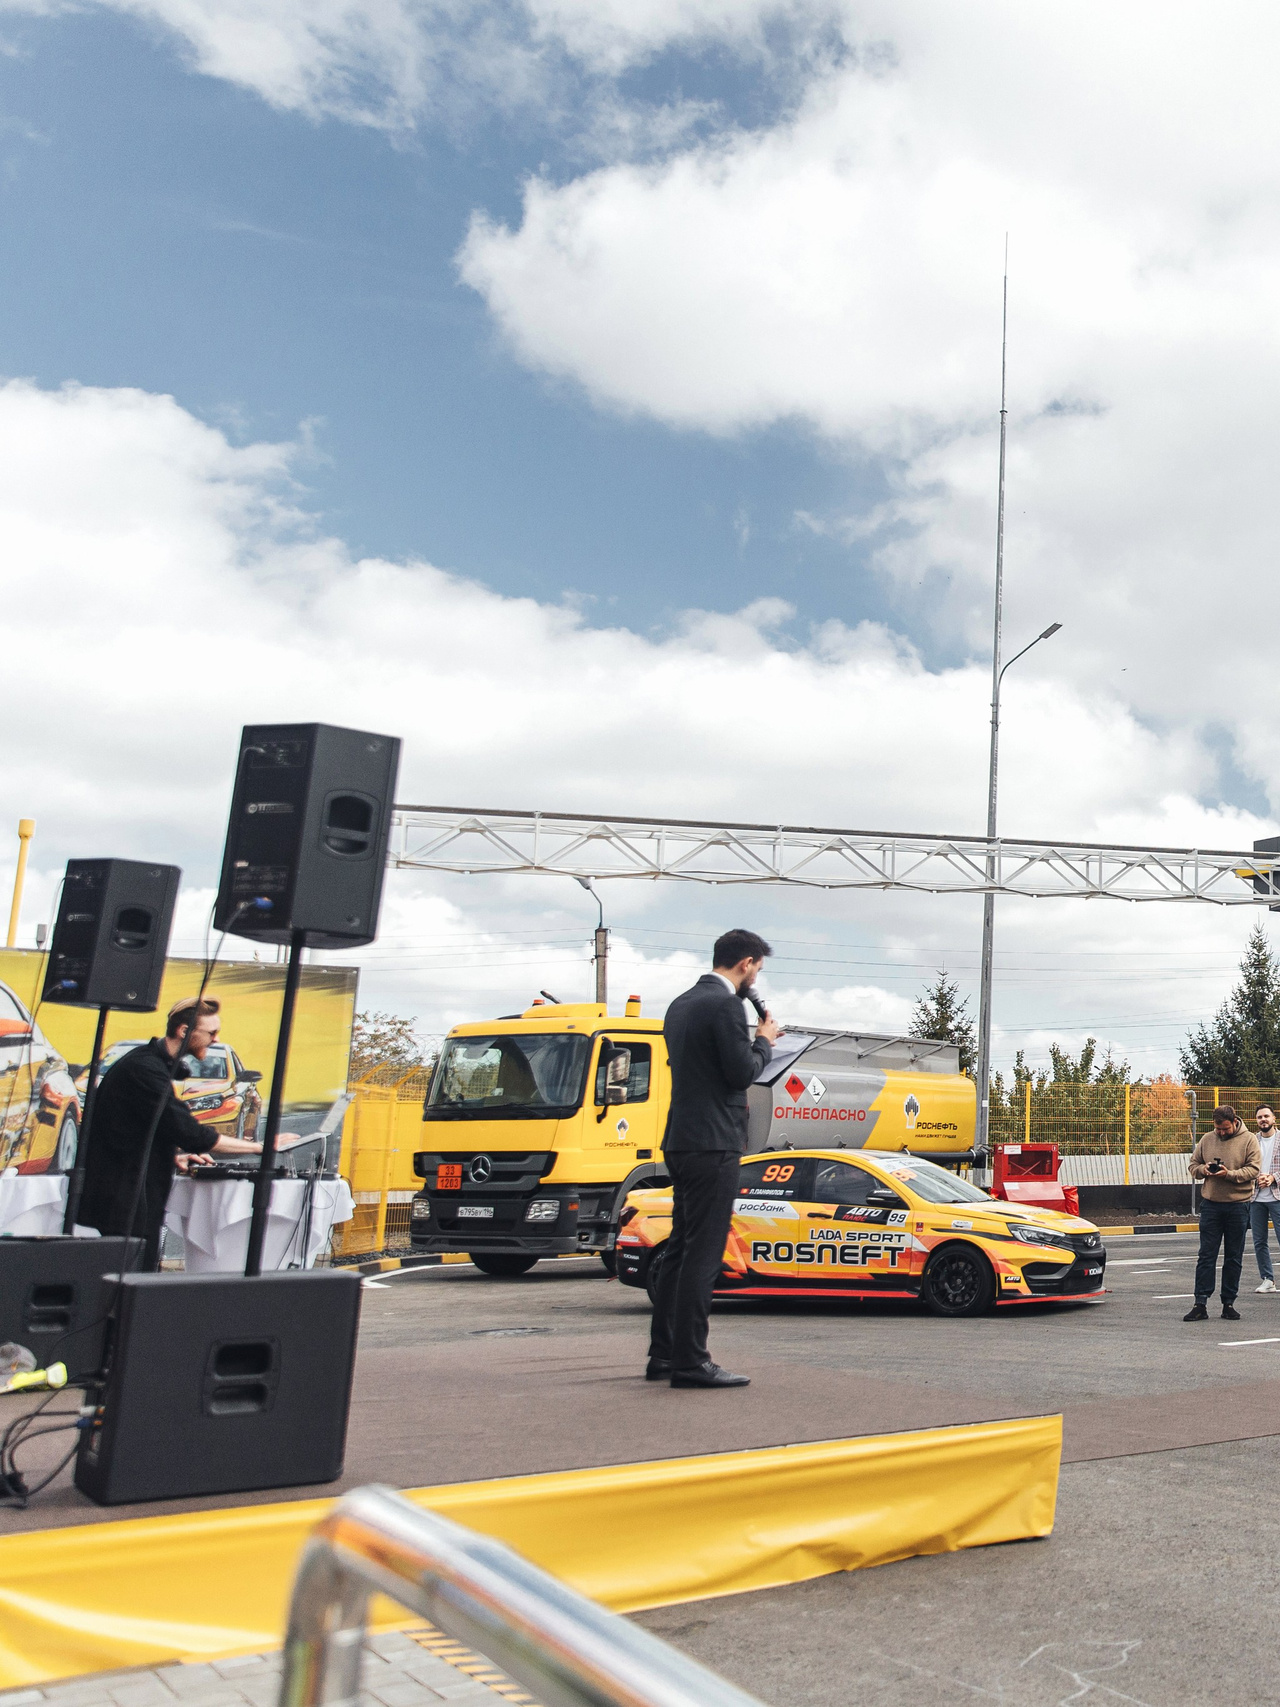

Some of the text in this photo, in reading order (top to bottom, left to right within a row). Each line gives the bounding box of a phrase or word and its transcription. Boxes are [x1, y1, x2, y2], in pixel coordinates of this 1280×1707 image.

[774, 1106, 866, 1122] ОГНЕОПАСНО
[916, 1121, 958, 1130] РОСНЕФТЬ
[445, 1165, 455, 1175] 33
[762, 1164, 795, 1183] 99
[440, 1178, 459, 1188] 1203
[738, 1202, 786, 1212] росбанк
[846, 1207, 883, 1217] АВТО
[842, 1214, 868, 1222] ПЛЮС
[889, 1213, 907, 1223] 99
[810, 1229, 906, 1243] LADA SPORT
[752, 1241, 907, 1268] ROSNEFT
